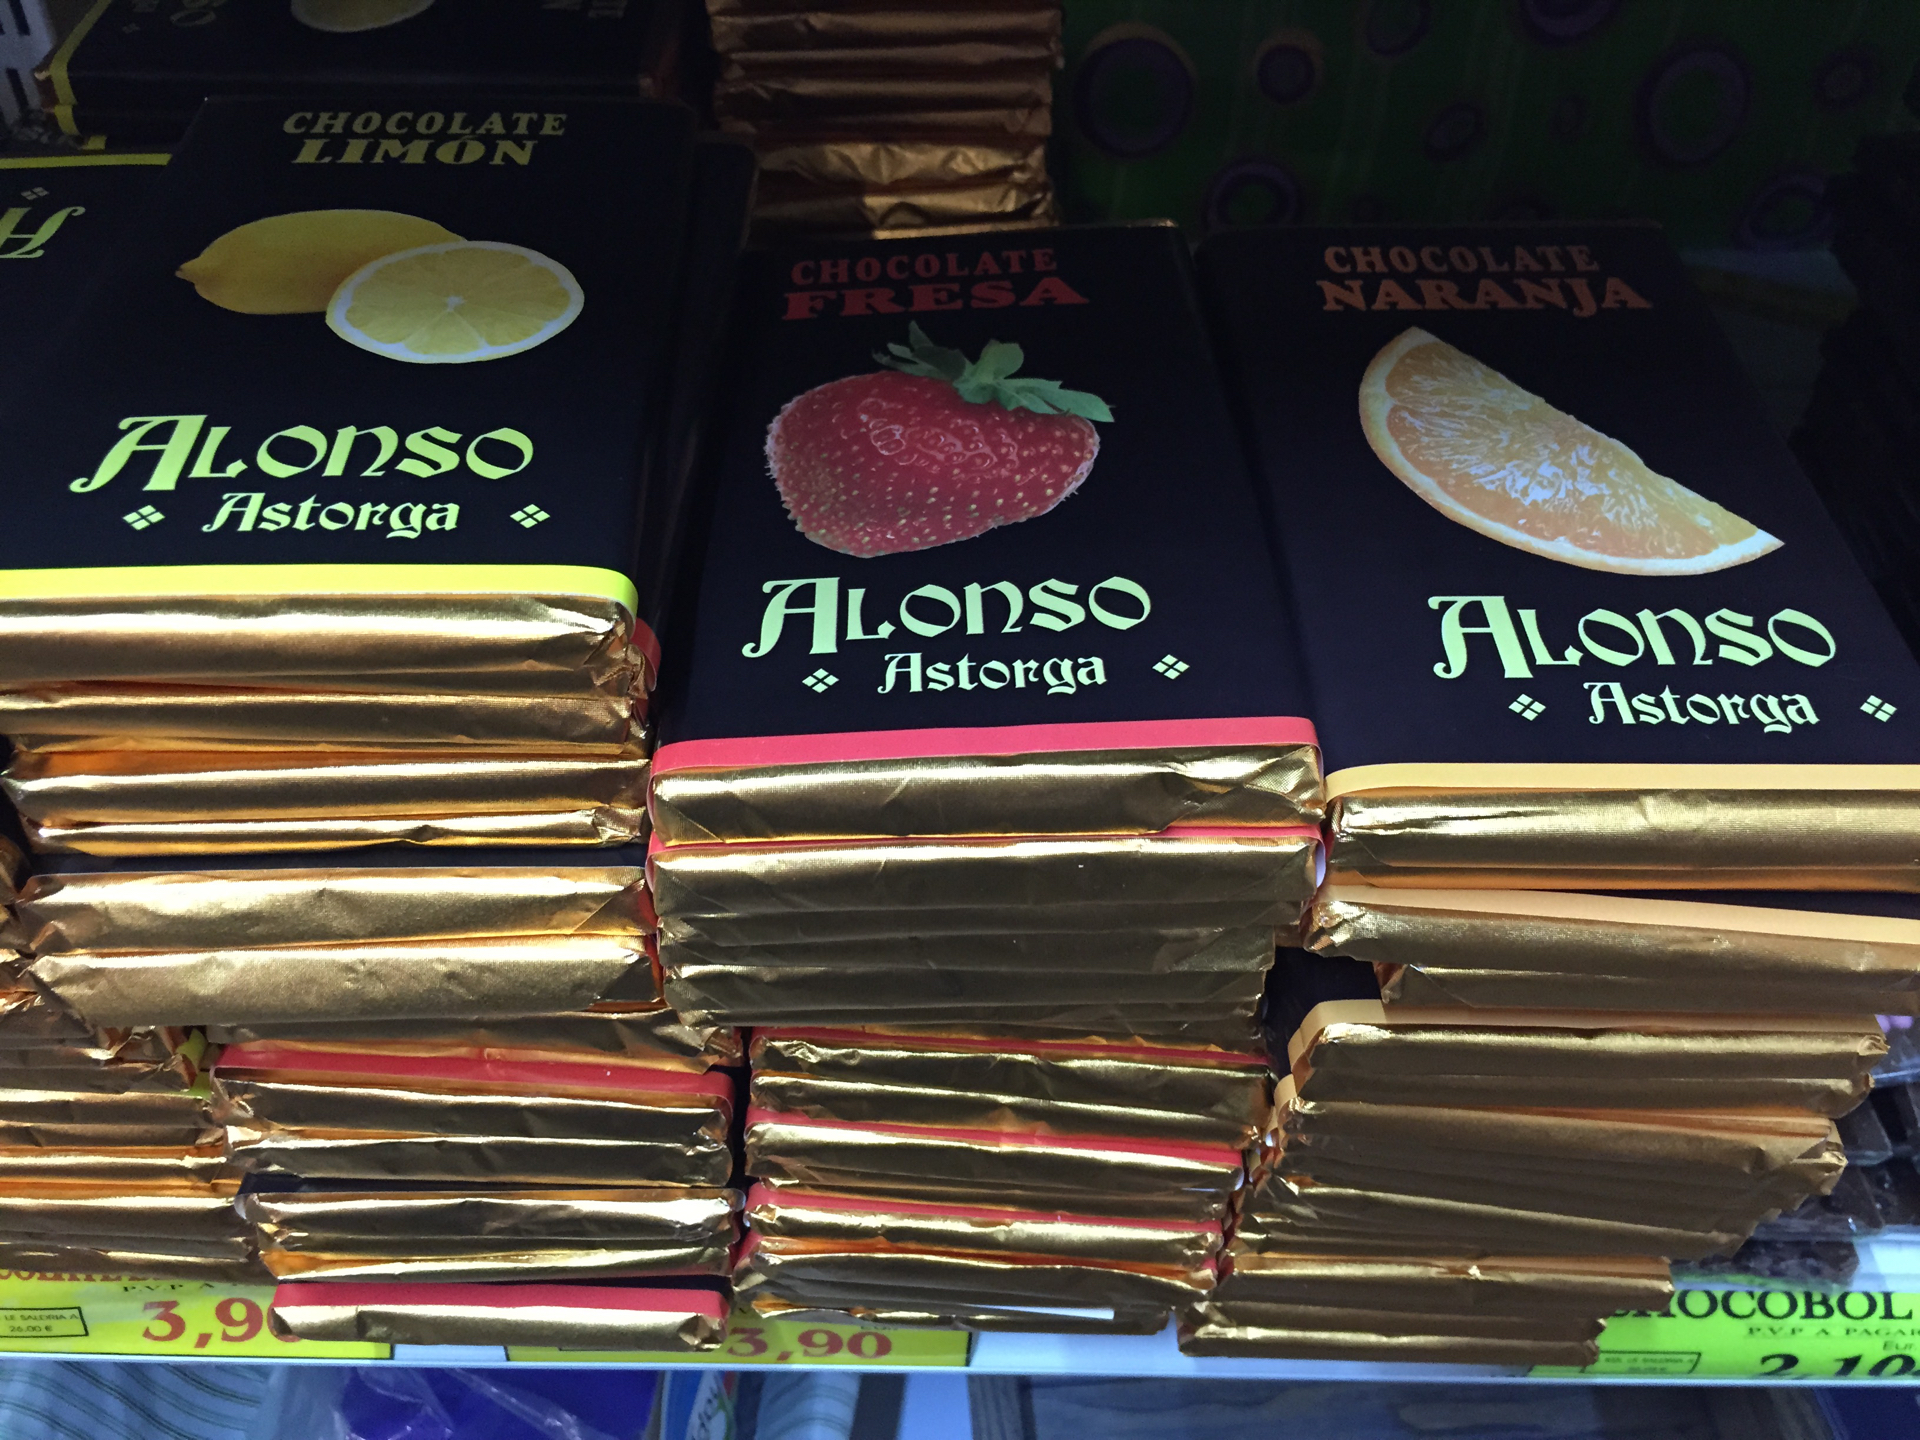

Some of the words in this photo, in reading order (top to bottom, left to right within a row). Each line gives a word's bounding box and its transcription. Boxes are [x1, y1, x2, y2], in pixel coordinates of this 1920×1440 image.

[282, 111, 567, 136] CHOCOLATE
[791, 248, 1058, 285] CHOCOLATE
[1323, 245, 1600, 274] CHOCOLATE
[782, 277, 1090, 320] FRESA
[1316, 277, 1654, 318] NARANJA
[202, 492, 460, 539] Astorga
[877, 652, 1108, 695] Astorga
[1583, 682, 1820, 734] Astorga
[1612, 1289, 1913, 1320] OCOBOL
[727, 1327, 893, 1362] 3,90
